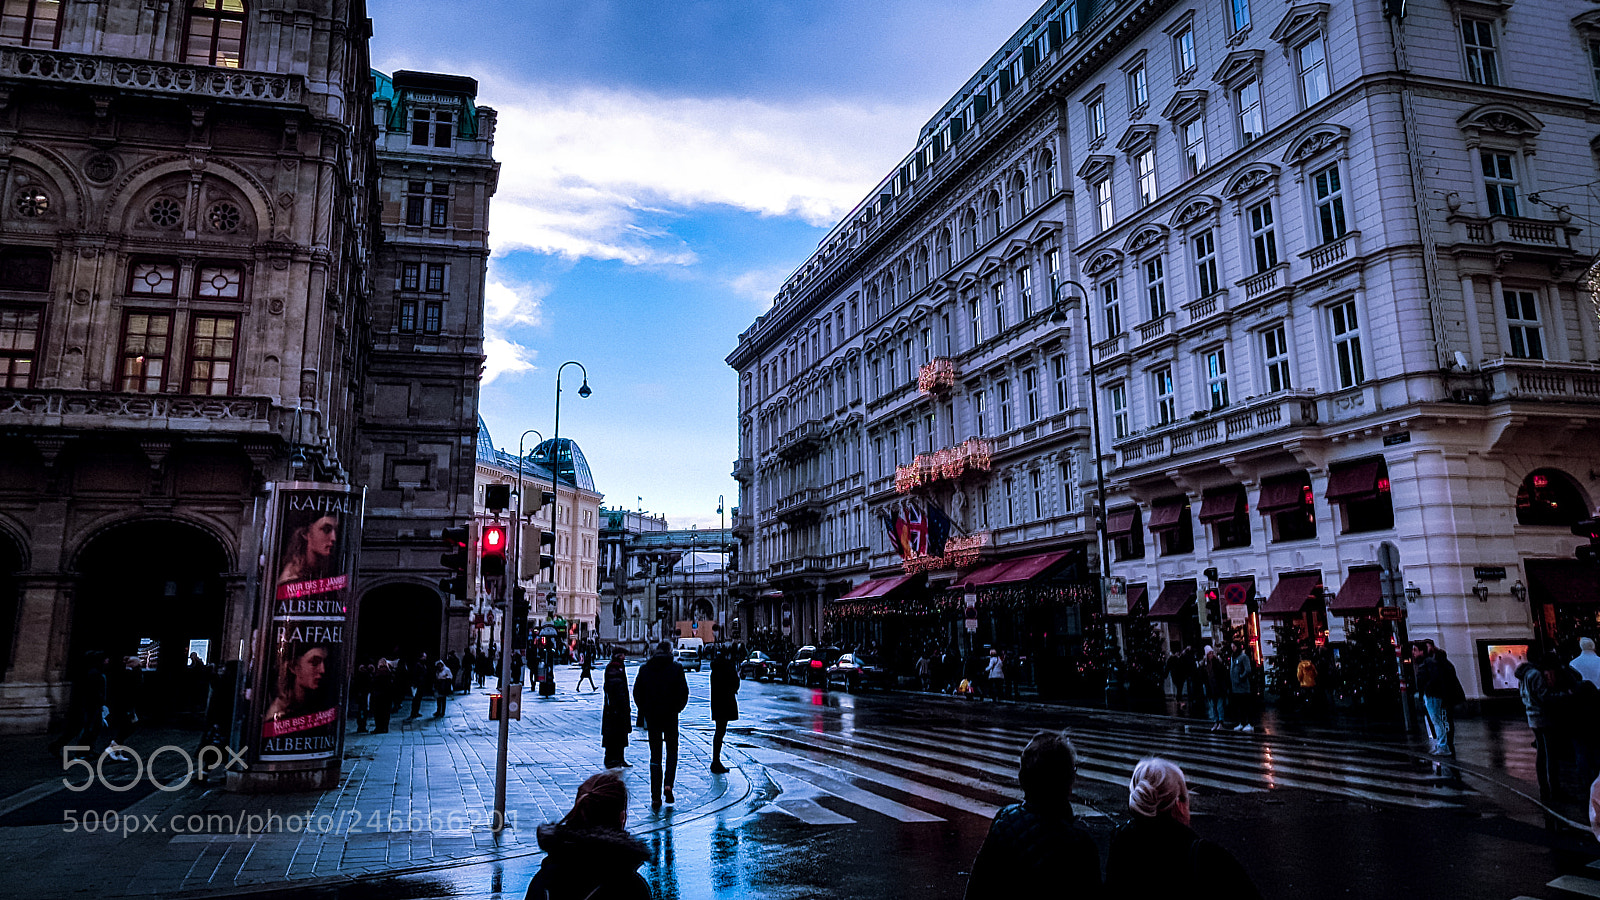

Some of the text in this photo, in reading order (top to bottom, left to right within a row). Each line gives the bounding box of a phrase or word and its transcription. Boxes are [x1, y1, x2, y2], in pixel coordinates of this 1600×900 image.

[289, 495, 353, 514] RAFFAEL
[287, 583, 303, 593] NUR
[304, 580, 317, 590] BIS
[276, 626, 343, 644] RAFFAEL
[274, 719, 290, 730] NUR
[292, 716, 305, 726] BIS
